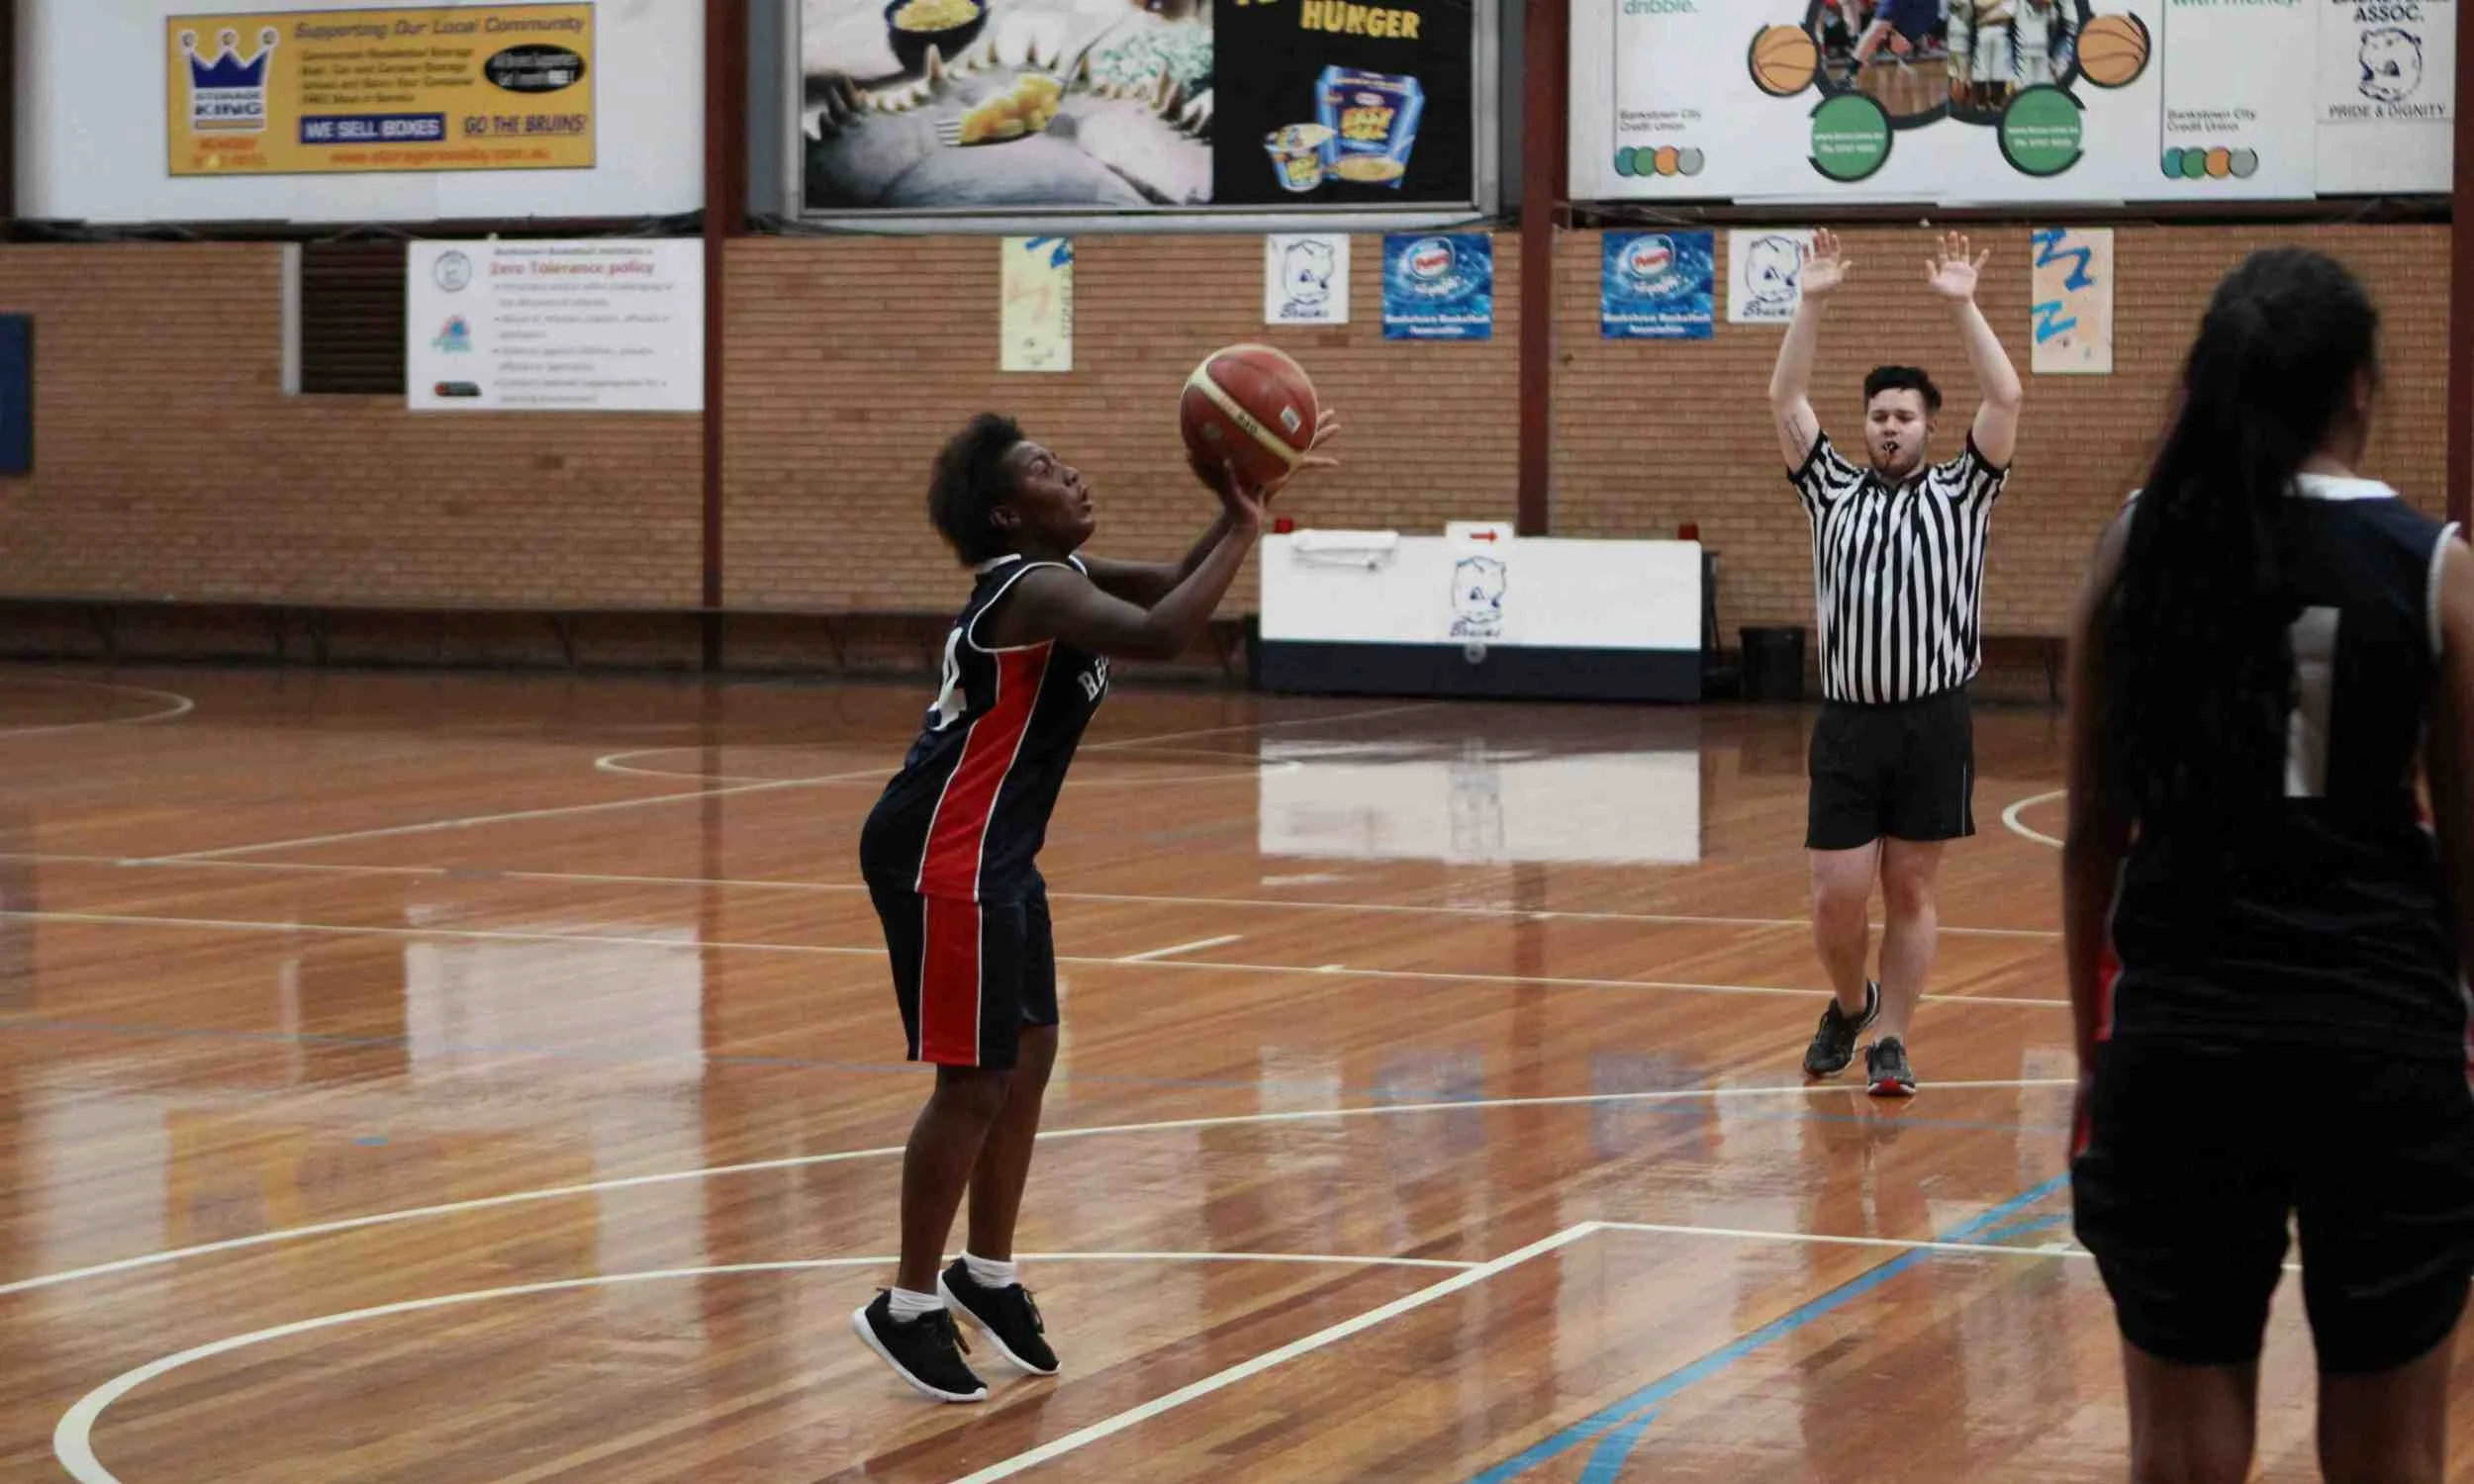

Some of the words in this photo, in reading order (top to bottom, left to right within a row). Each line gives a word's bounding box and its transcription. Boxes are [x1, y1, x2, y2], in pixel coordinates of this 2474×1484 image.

[1299, 0, 1421, 39] HUNGER
[2354, 4, 2425, 23] ASSOC.
[294, 22, 389, 41] Supporting
[395, 20, 427, 35] Our
[433, 20, 477, 34] Local
[485, 16, 584, 34] Community
[195, 102, 262, 116] KING
[1619, 110, 1679, 120] Bankstown
[1680, 108, 1702, 121] City
[2167, 109, 2231, 120] Bankstown
[2234, 108, 2257, 121] City
[2329, 103, 2370, 118] PRIDE
[2388, 103, 2446, 118] DIGNITY
[305, 120, 333, 138] WE
[337, 120, 377, 138] SELL
[382, 119, 439, 137] BOXES
[464, 116, 487, 134] GO
[495, 115, 519, 133] THE
[1655, 122, 1686, 132] Union
[2167, 121, 2202, 132] Credit
[2205, 122, 2240, 133] Union
[490, 261, 525, 276] Zero
[530, 260, 603, 276] Tolerance
[609, 260, 655, 278] policy
